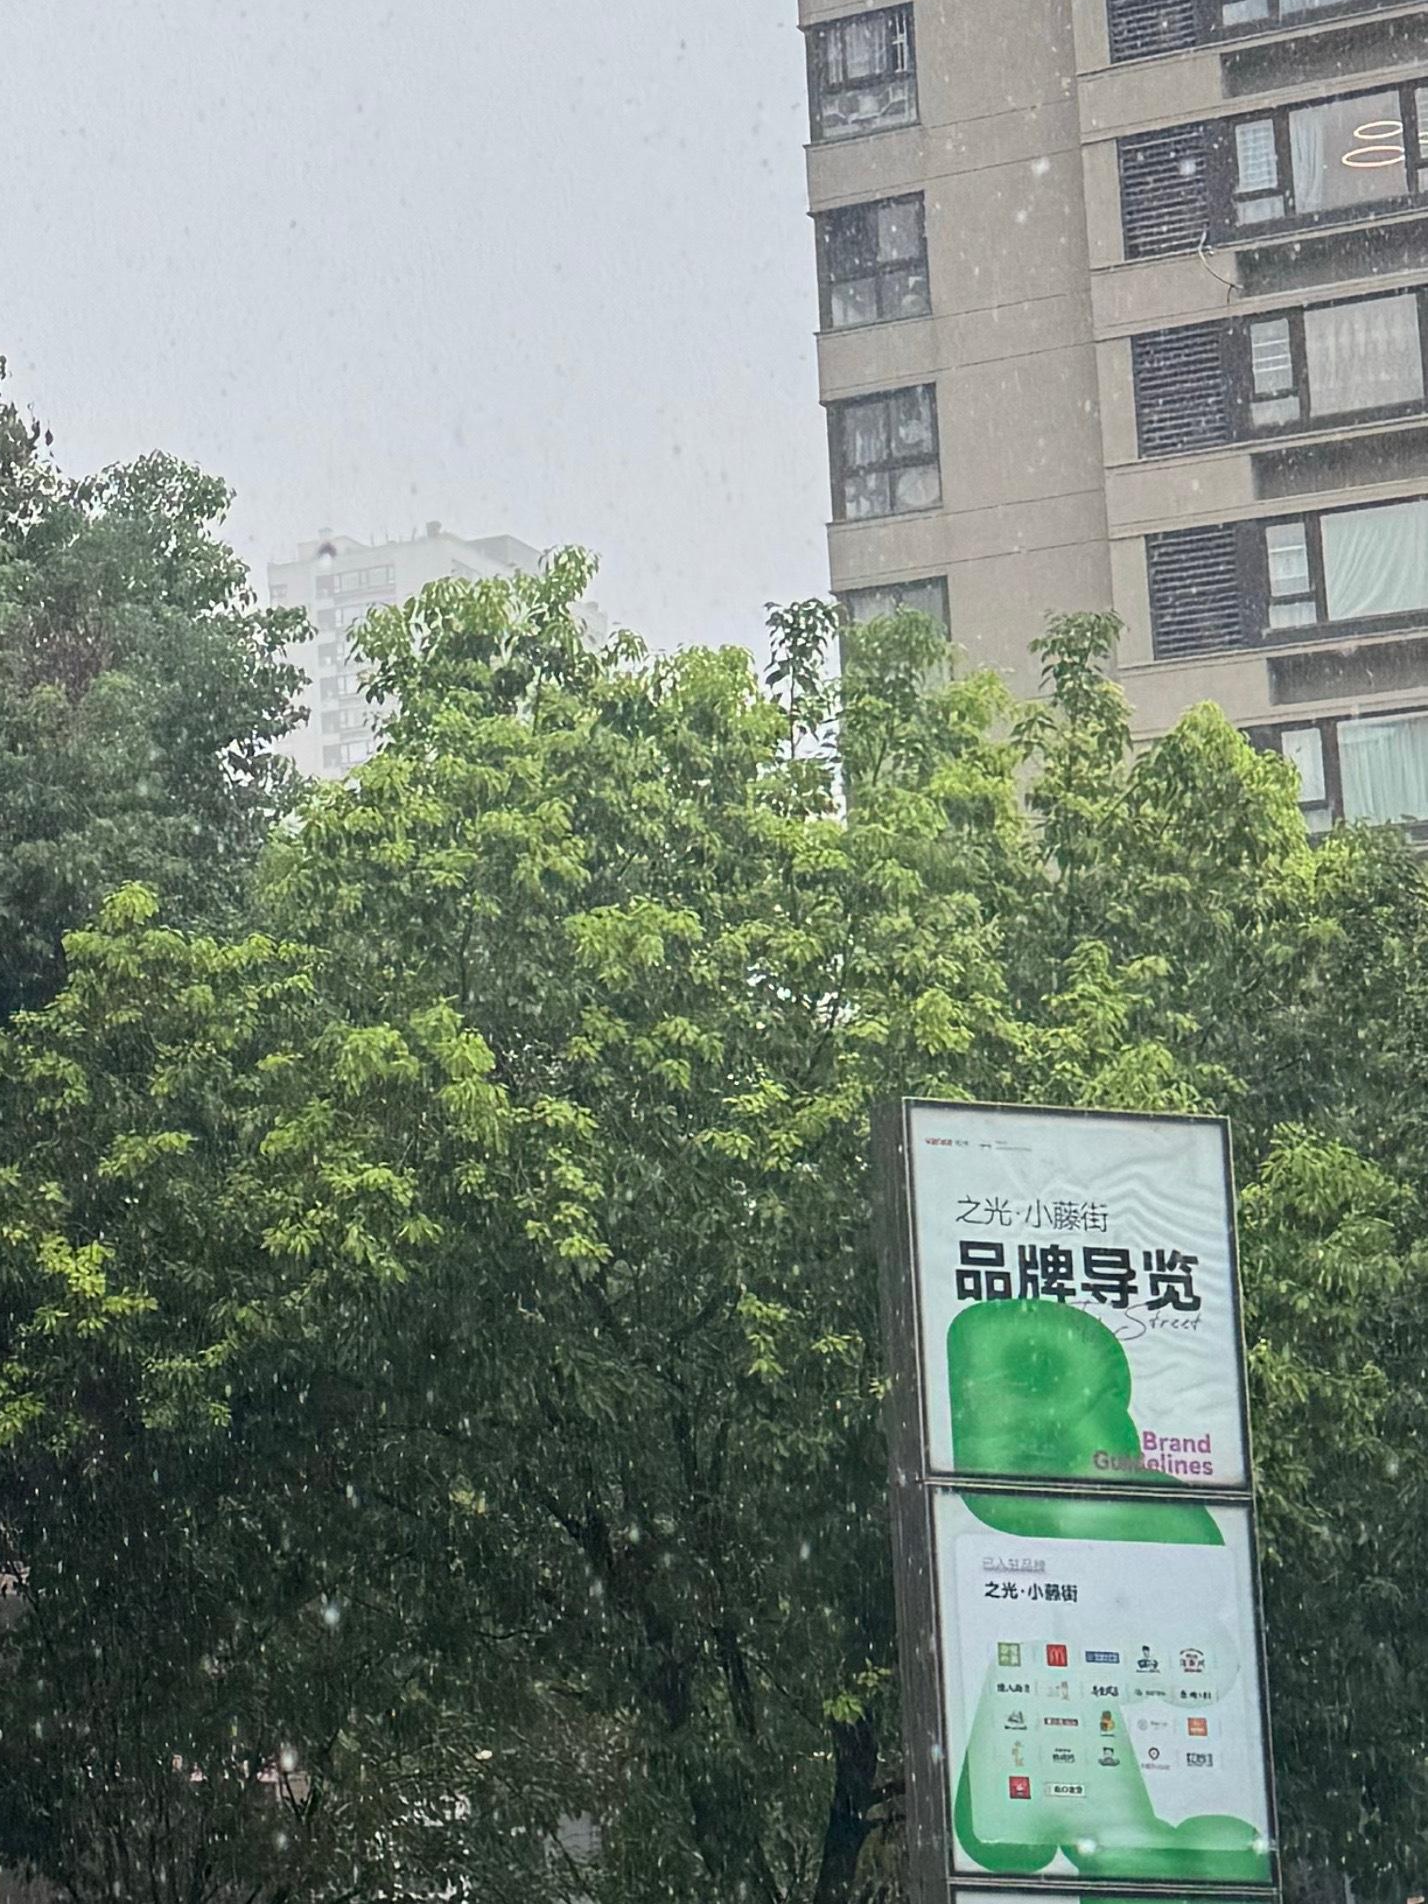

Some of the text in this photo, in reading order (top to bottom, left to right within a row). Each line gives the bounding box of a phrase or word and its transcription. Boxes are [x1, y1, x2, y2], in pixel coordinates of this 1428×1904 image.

[955, 1194, 1109, 1233] 之光·小藤街
[955, 1240, 1202, 1312] 品牌导览
[1142, 1430, 1212, 1455] Brand
[1093, 1449, 1214, 1476] Guelines
